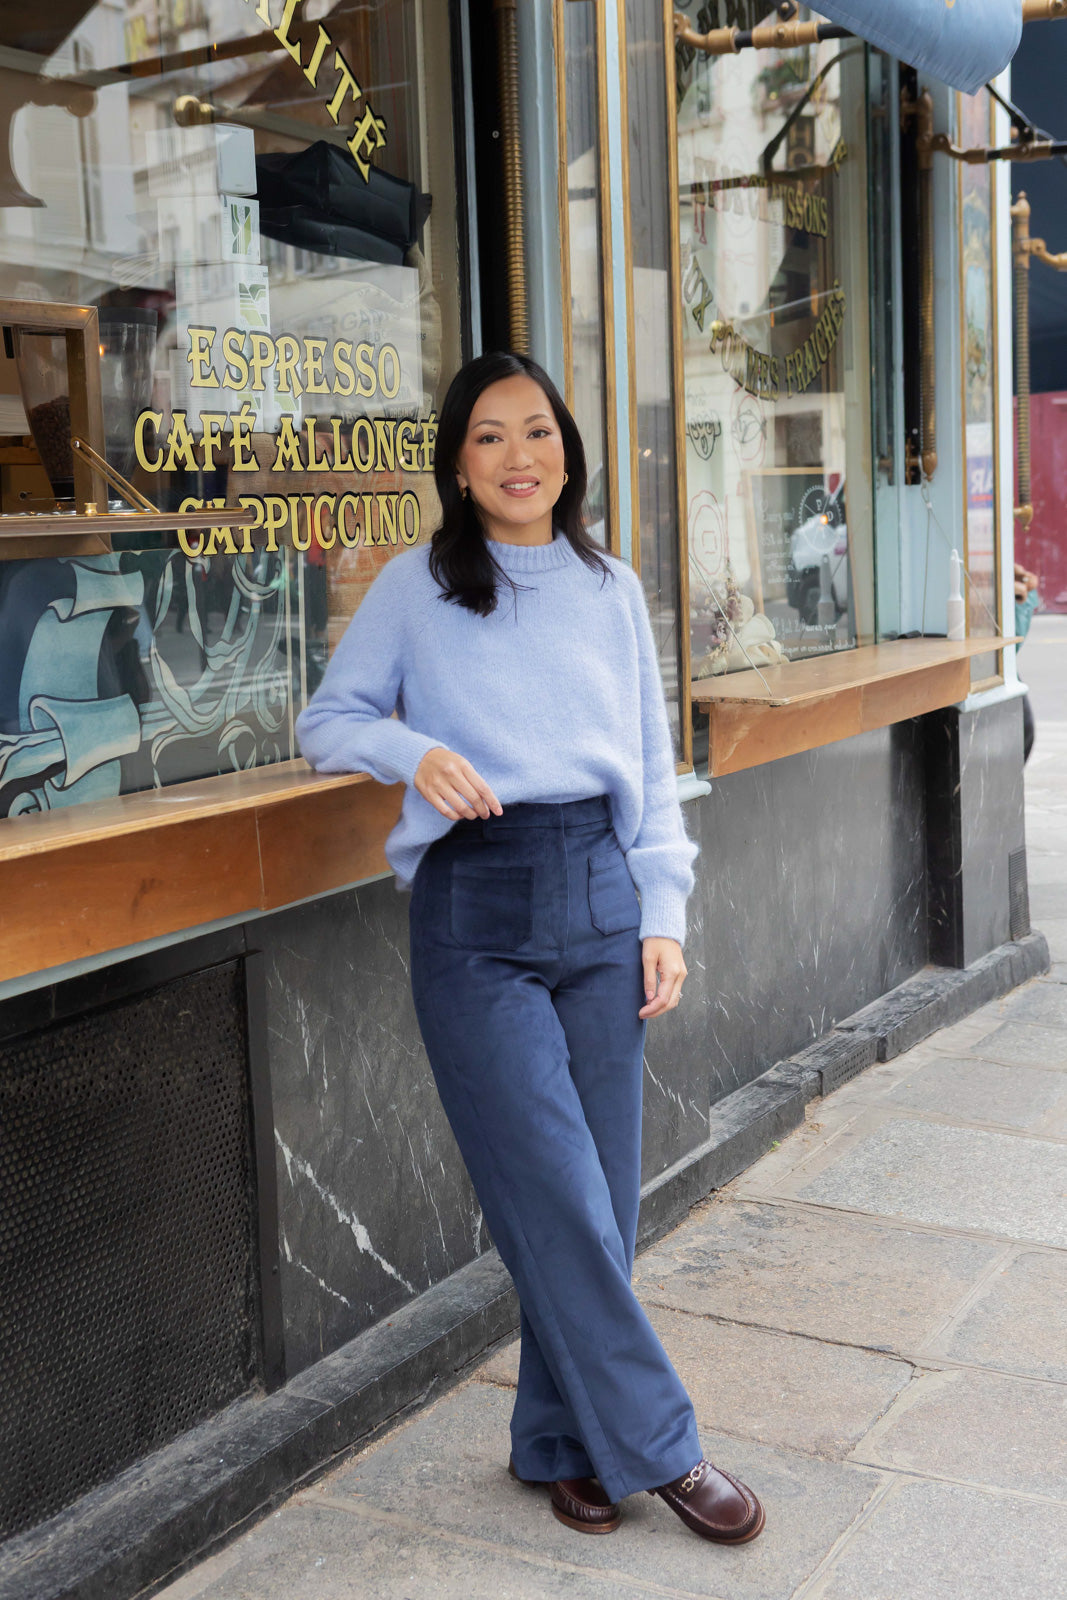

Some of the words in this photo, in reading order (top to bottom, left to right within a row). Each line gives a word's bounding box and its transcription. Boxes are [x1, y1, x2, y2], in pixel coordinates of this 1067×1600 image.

[256, 0, 387, 184] LITÉ
[187, 325, 402, 398] ESPRESSO
[134, 401, 260, 472] CAFÉ
[272, 410, 439, 472] ALLONGÉ
[176, 490, 421, 558] CAPPUCCINO
